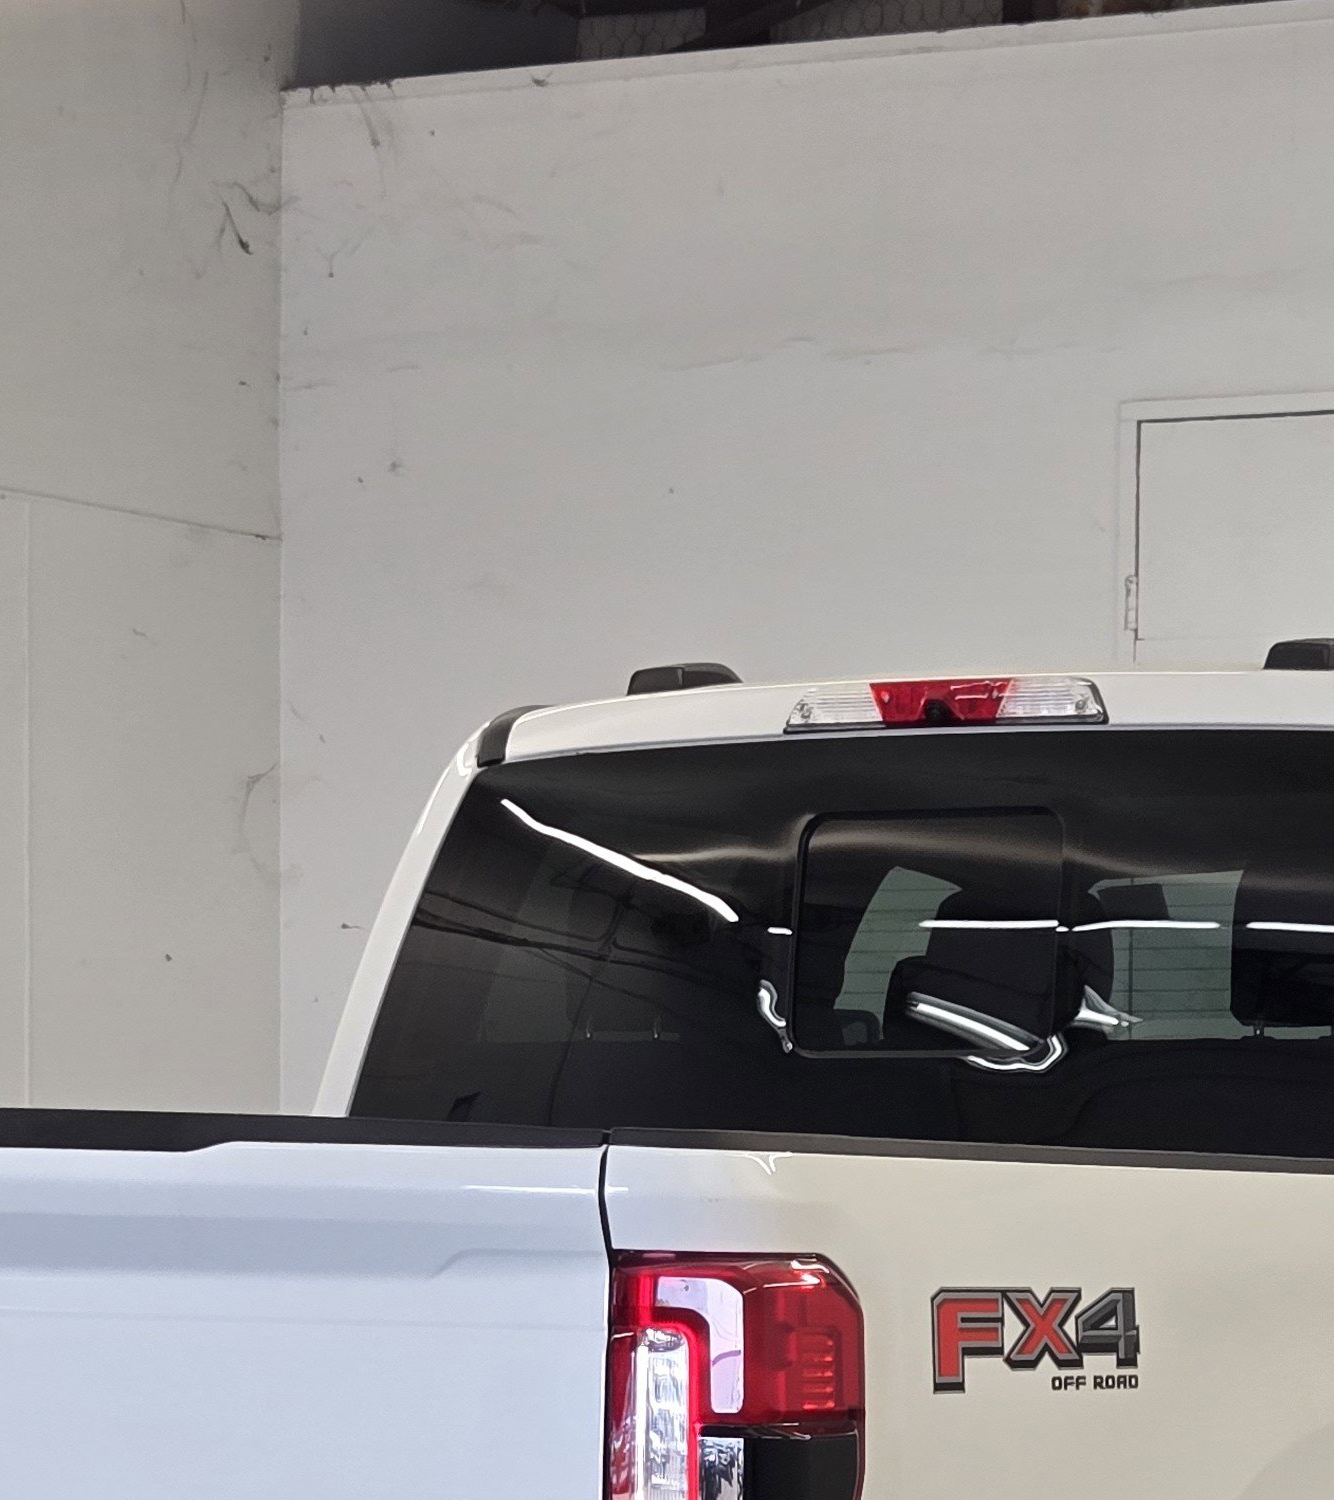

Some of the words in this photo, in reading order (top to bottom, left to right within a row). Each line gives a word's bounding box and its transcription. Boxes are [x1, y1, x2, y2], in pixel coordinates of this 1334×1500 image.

[931, 1287, 1140, 1393] FX4
[1051, 1375, 1087, 1390] OFF
[1093, 1374, 1139, 1390] ROAD
